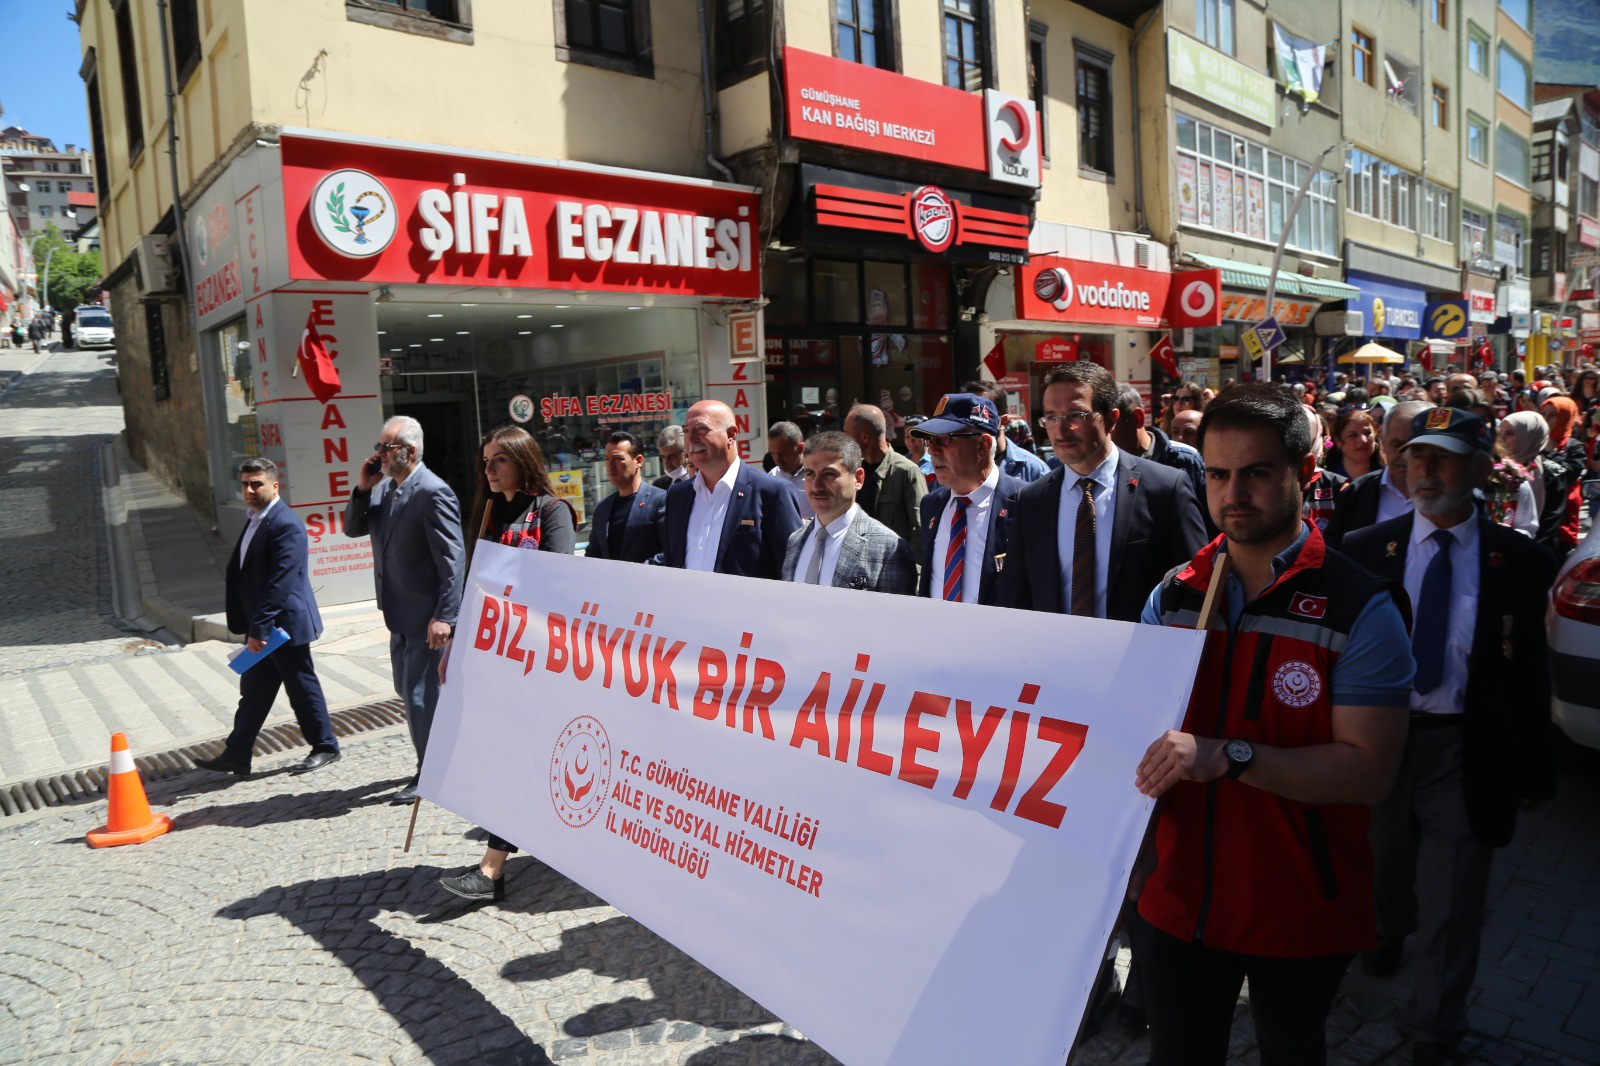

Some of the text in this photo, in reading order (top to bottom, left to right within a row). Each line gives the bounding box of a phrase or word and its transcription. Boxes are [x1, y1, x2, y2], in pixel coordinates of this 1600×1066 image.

[801, 88, 860, 110] GÜMÜŞHANE
[802, 106, 935, 146] KAN BAĞIŞI MERKEZİ
[418, 172, 752, 272] ŞİFA ECZANESİ
[1077, 281, 1150, 311] vodafone
[541, 392, 583, 423] ŞİFA
[587, 389, 672, 416] ECZANESİ
[474, 585, 1090, 830] BİZ, BÜYÜK BİR AİLEYİZ
[620, 749, 820, 850] T.C. GÜMÜŞHANE VALİLİĞİ
[605, 809, 710, 880] İL MÜDÜRLÜĞÜ
[611, 780, 824, 898] AİLE VE SOSYAL HİZMETLER
